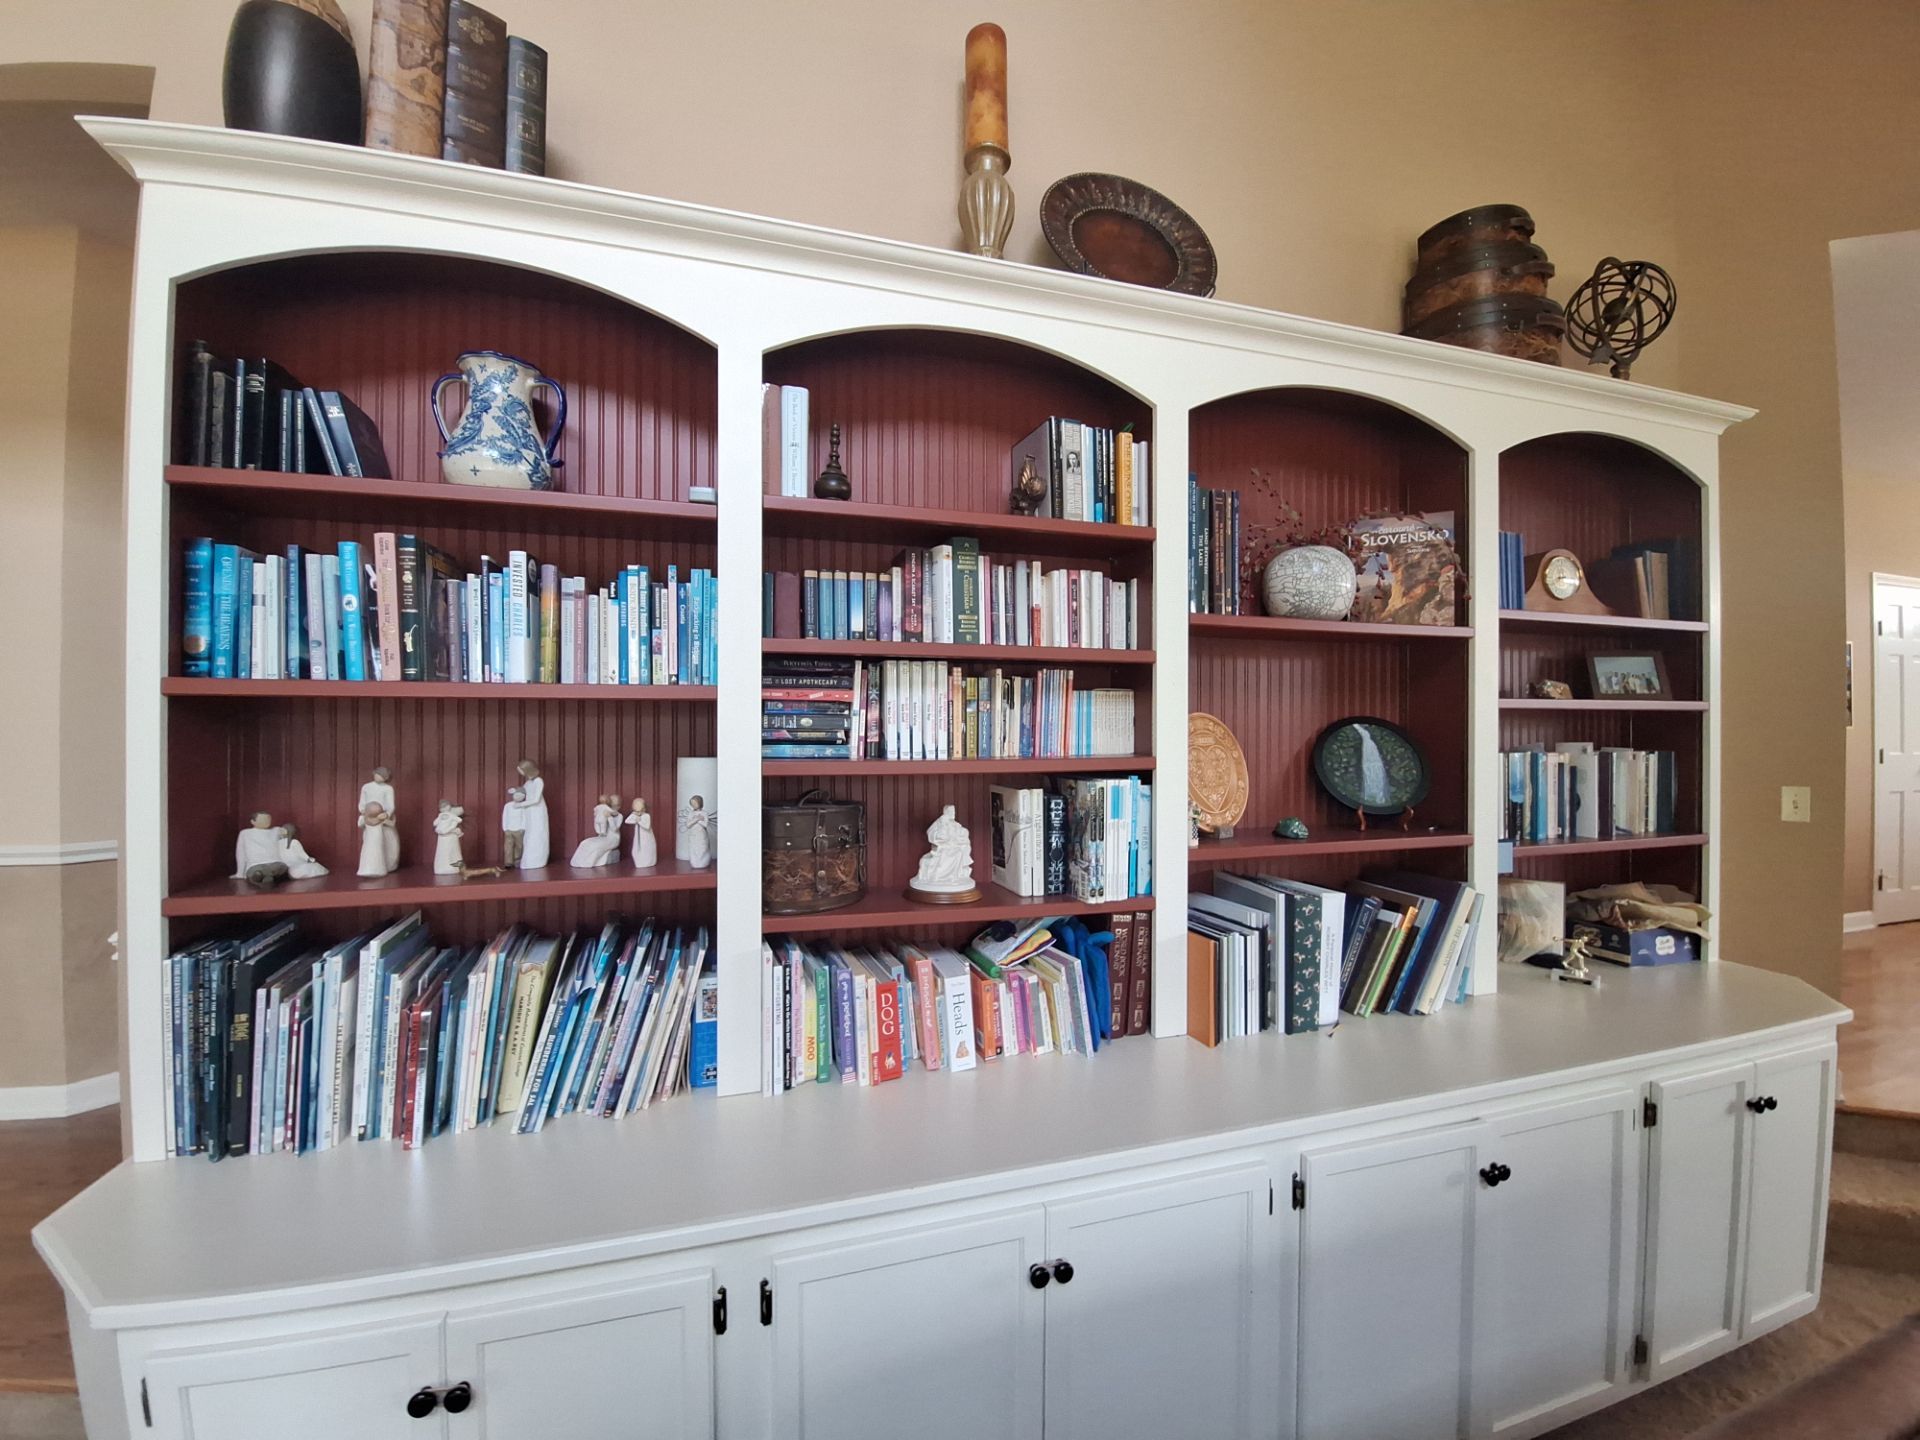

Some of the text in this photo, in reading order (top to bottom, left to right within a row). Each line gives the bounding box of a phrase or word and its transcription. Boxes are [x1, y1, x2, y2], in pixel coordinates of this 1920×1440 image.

[1360, 529, 1449, 547] SLOVENSKO
[512, 561, 523, 598] INVESTED
[218, 556, 232, 650] OPENING THE HEAVENS
[512, 603, 523, 638] CHARLES
[691, 597, 702, 633] Backpacking
[798, 678, 838, 686] APOTHECARY
[1141, 831, 1149, 855] HERBS
[881, 993, 895, 1035] DOG
[953, 993, 967, 1036] Heads
[807, 1036, 816, 1061] MOO
[527, 1034, 556, 1107] BLUEBERRIES FOR SAL
